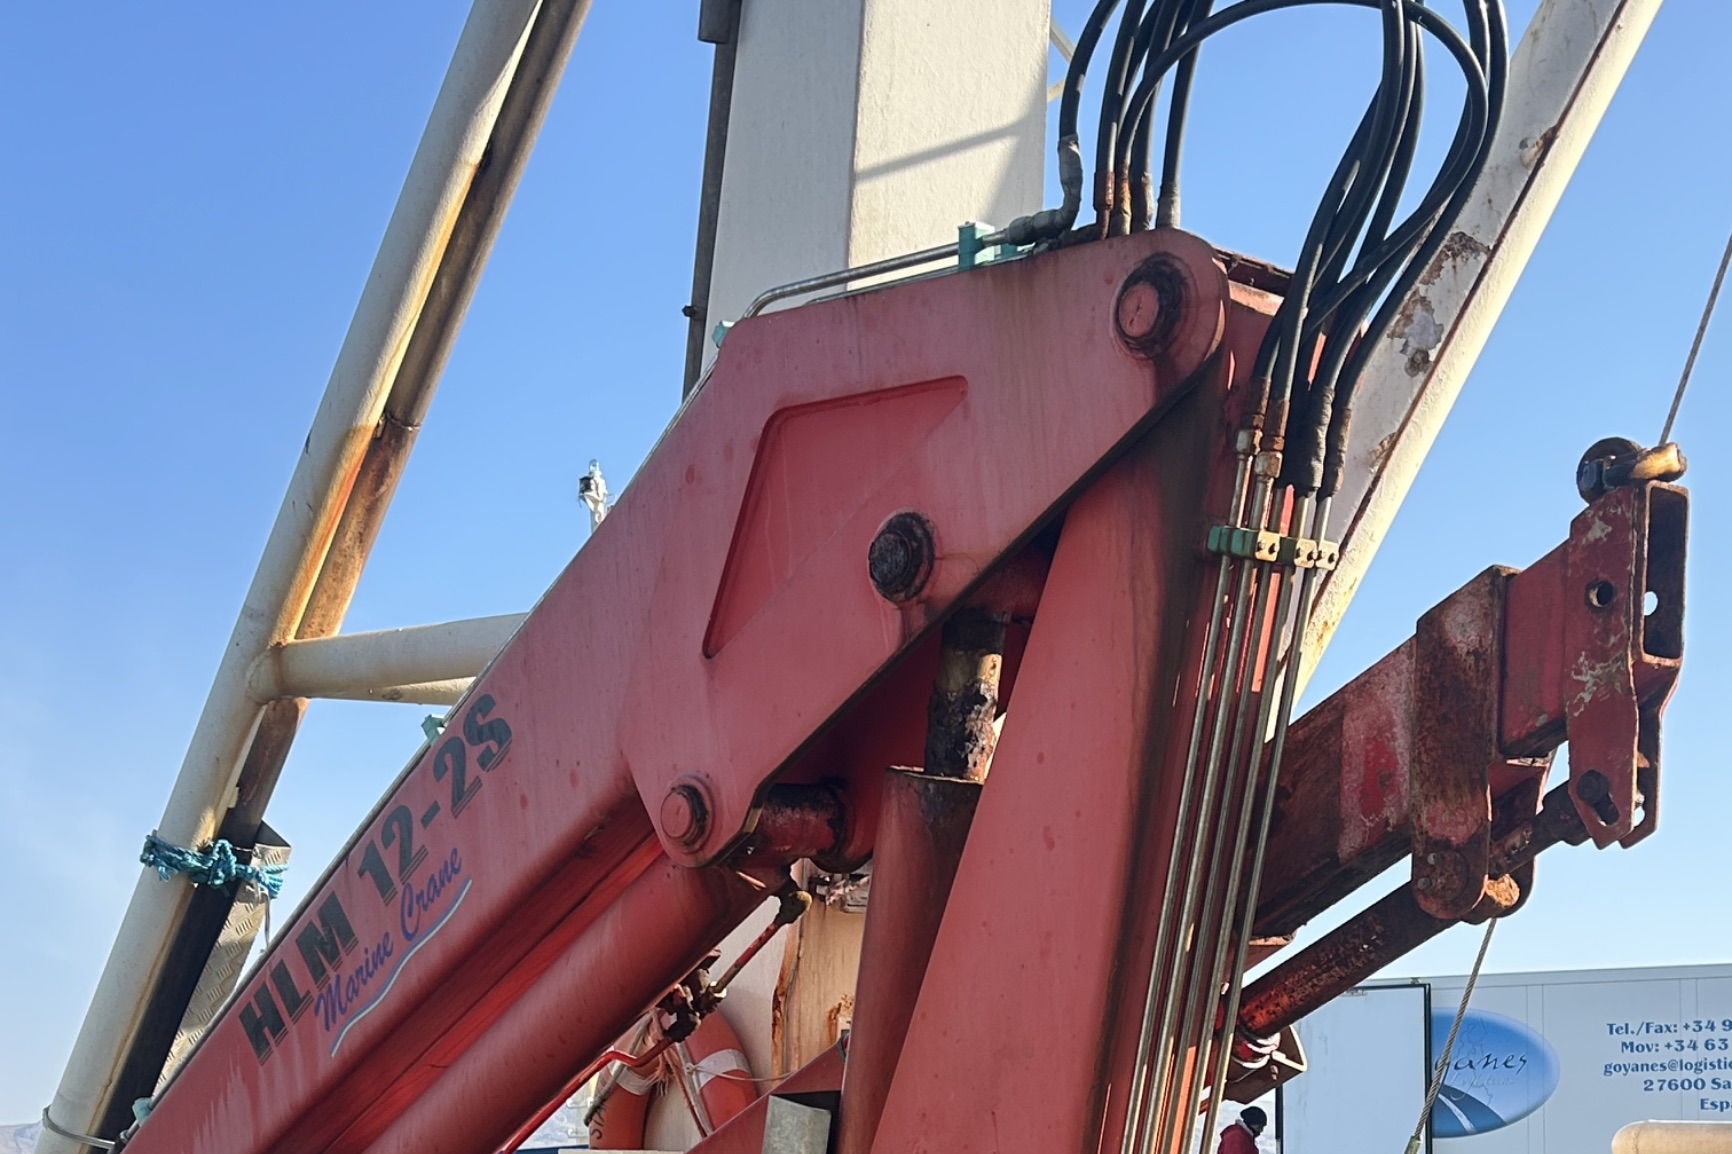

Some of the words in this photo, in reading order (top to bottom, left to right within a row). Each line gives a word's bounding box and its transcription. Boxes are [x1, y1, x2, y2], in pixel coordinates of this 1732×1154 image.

[238, 890, 358, 1065] HLM
[356, 692, 513, 906] 12-2S
[314, 932, 394, 1032] Marine
[400, 847, 463, 941] Crane
[1606, 1021, 1678, 1036] Tel./Fax:
[1683, 1019, 1716, 1032] +34
[1621, 1040, 1660, 1053] Mov:
[1664, 1039, 1699, 1052] +34
[1700, 1097, 1732, 1112] Esp
